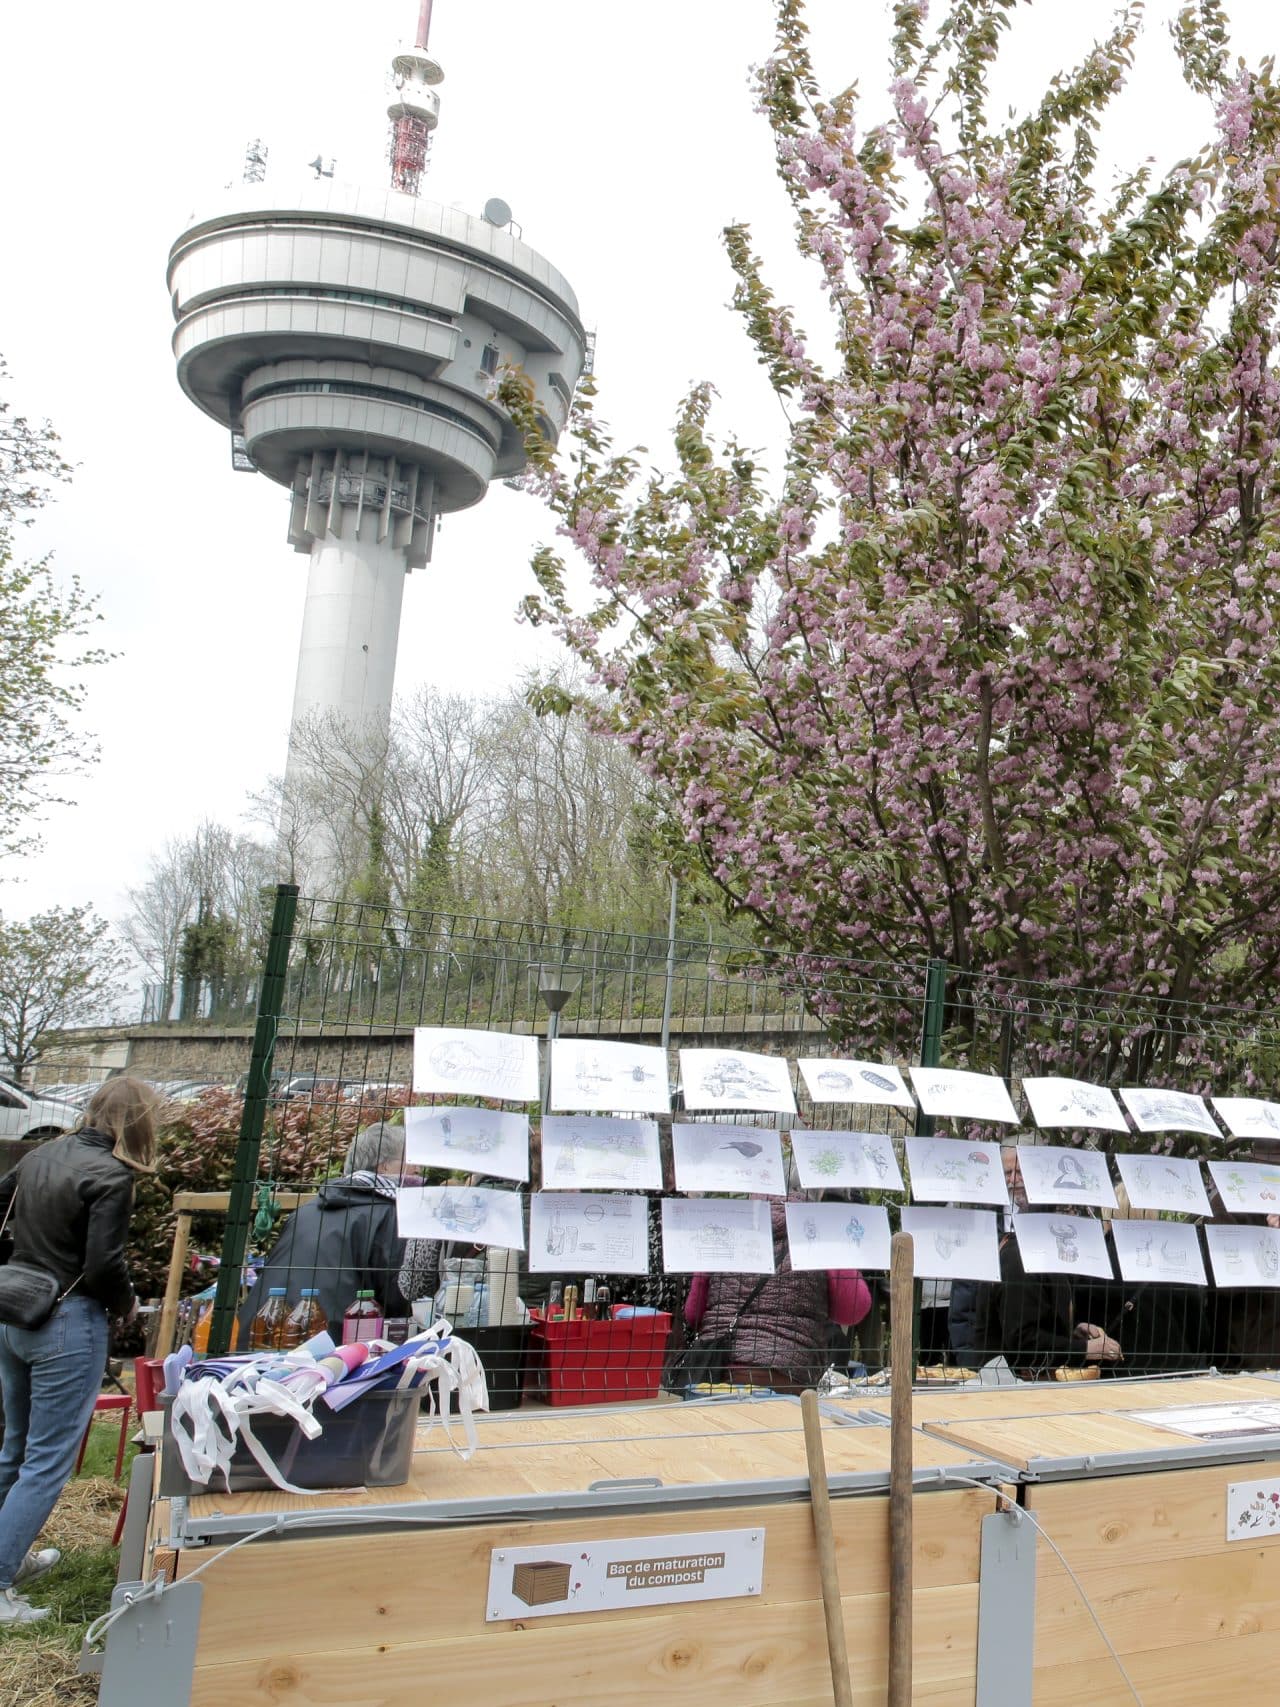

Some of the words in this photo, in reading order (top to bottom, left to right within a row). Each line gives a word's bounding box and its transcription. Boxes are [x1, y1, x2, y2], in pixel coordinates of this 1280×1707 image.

[610, 1563, 632, 1575] Bac
[635, 1561, 650, 1573] de
[653, 1556, 721, 1571] maturation
[629, 1573, 646, 1586] du
[648, 1571, 702, 1585] compost
